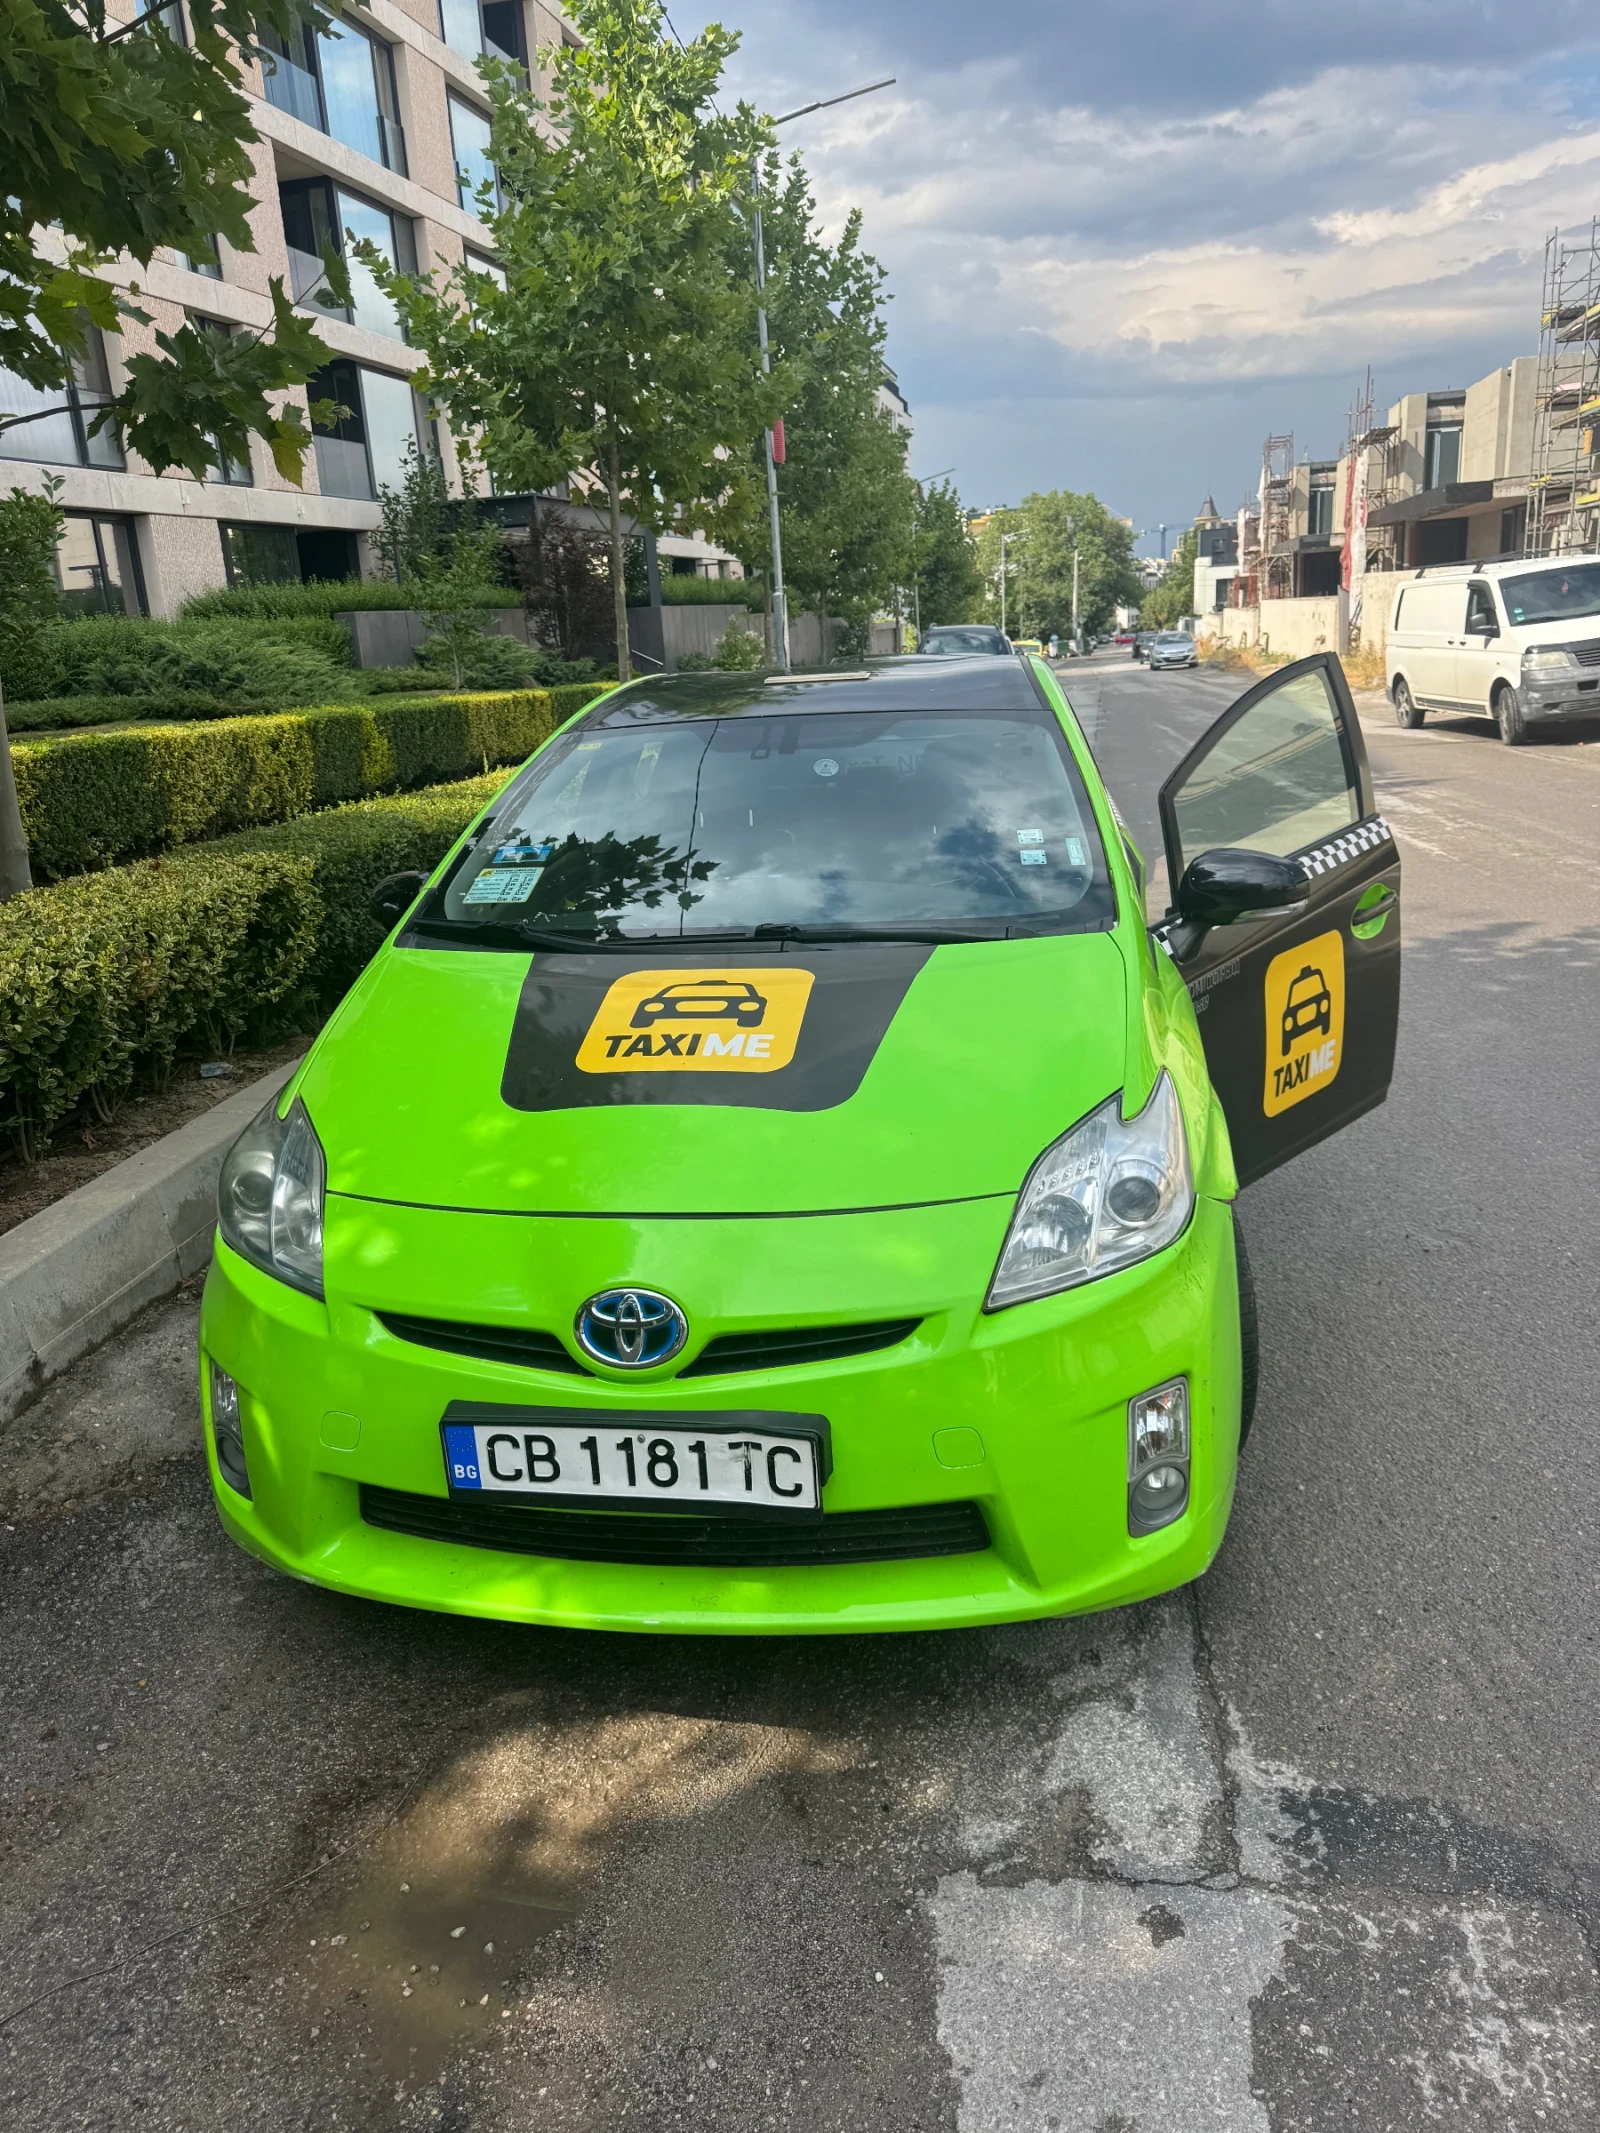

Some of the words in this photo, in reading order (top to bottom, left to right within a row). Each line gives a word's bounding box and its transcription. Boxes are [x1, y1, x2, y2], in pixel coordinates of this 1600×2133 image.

[605, 1033, 774, 1058] TAXIME
[1273, 1039, 1336, 1098] TAXIME
[454, 1464, 477, 1479] BG
[486, 1434, 561, 1483] CB
[580, 1435, 709, 1490] 1181
[728, 1441, 803, 1497] TC
